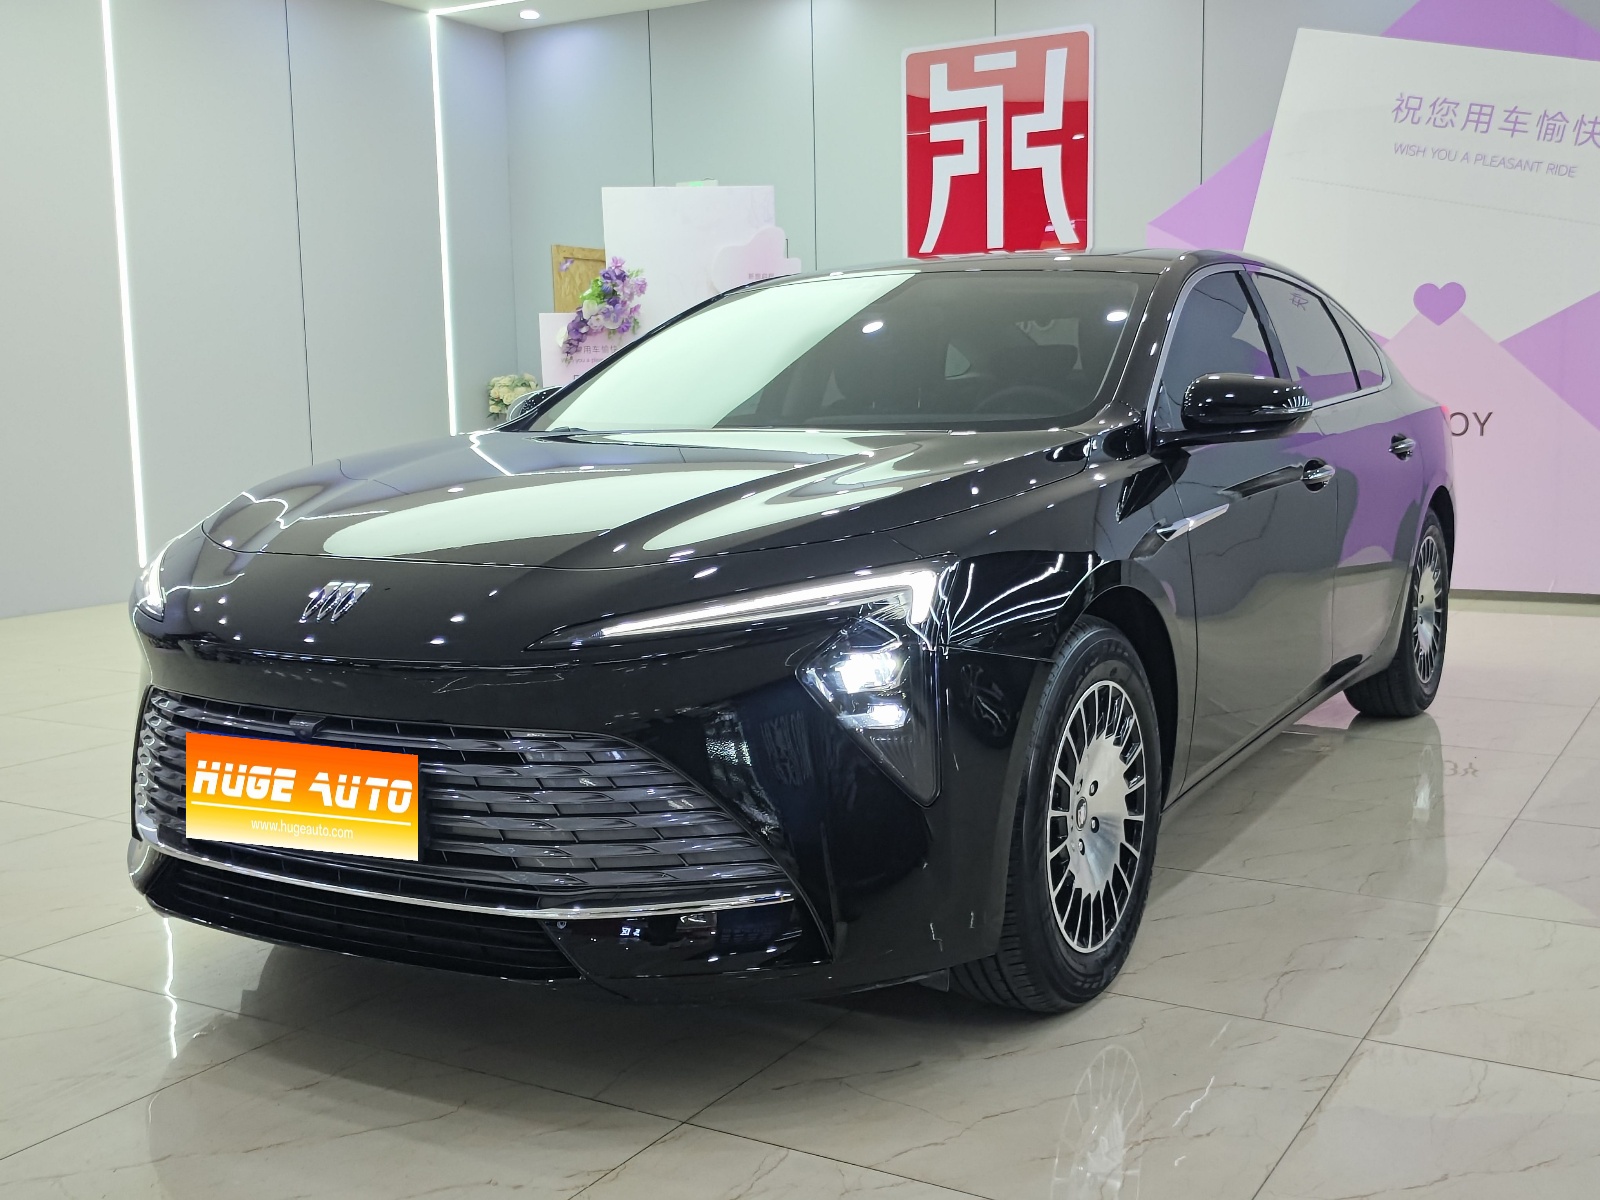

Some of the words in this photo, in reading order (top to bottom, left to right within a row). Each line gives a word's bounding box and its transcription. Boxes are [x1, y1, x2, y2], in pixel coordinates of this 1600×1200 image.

[1391, 92, 1600, 149] 祝您用车愉快
[1393, 143, 1426, 158] WISH
[1431, 147, 1458, 162] YOU
[1460, 152, 1470, 164] A
[1474, 153, 1544, 174] PLEASANT
[1545, 163, 1579, 178] RIDE
